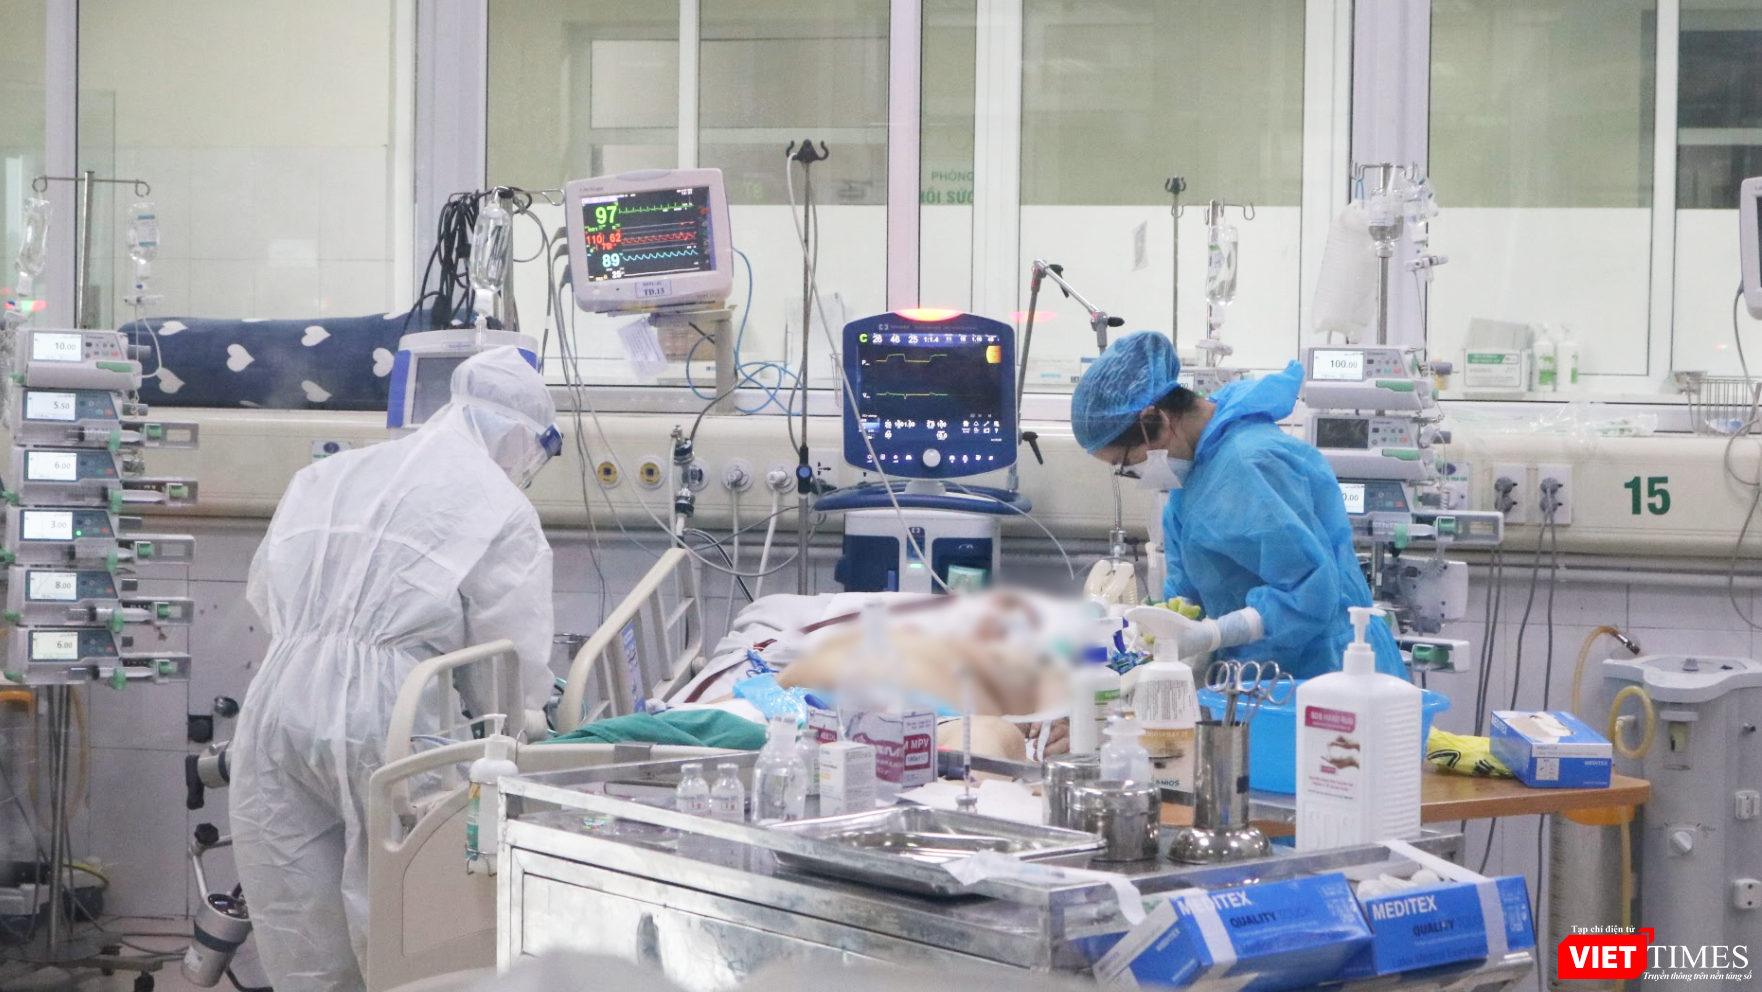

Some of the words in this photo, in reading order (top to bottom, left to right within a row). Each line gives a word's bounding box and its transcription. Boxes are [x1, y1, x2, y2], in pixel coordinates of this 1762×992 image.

[595, 205, 617, 224] 97
[602, 253, 620, 268] 89
[55, 342, 76, 351] 10.00
[1330, 360, 1358, 368] 100.00
[54, 401, 70, 410] 5.50
[54, 461, 71, 469] 6.00
[1624, 475, 1671, 515] 15
[51, 520, 67, 528] 3.00
[55, 581, 72, 589] 8.00
[57, 641, 73, 649] 6.00
[1372, 895, 1438, 921] MEDITEX
[1229, 911, 1278, 928] QUALITY
[1412, 919, 1455, 937] QUALITY
